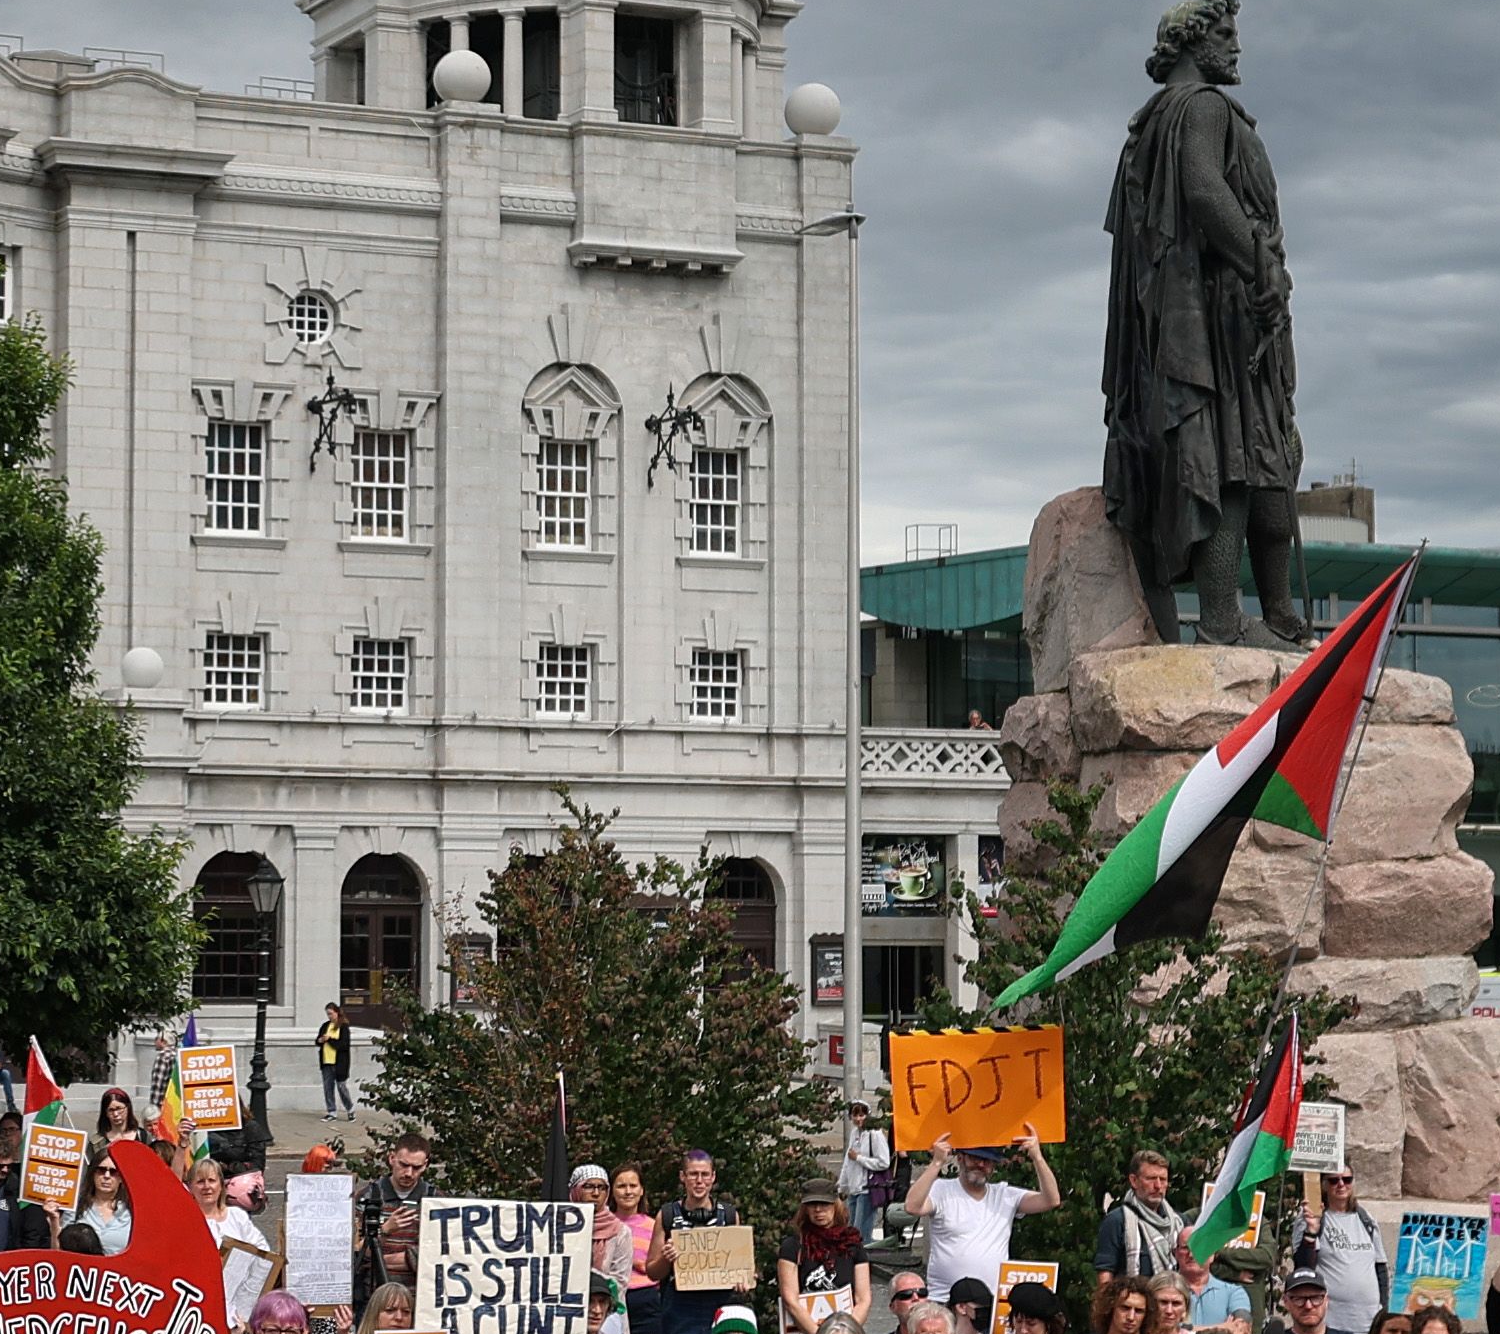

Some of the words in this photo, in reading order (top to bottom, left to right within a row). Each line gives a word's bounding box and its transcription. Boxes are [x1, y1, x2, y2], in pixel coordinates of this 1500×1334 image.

[188, 1054, 226, 1069] STOP
[182, 1068, 232, 1082] TRUMP
[907, 1048, 1050, 1115] FDJT
[37, 1133, 77, 1149] STOP
[30, 1145, 80, 1164] TRUMP
[429, 1203, 587, 1257] TRUMP
[1402, 1215, 1455, 1226] DONALD
[679, 1230, 722, 1253] JANEY
[677, 1250, 732, 1271] GODLEY
[434, 1261, 472, 1308] IS
[480, 1255, 585, 1307] STILL
[66, 1267, 164, 1320] NEXT
